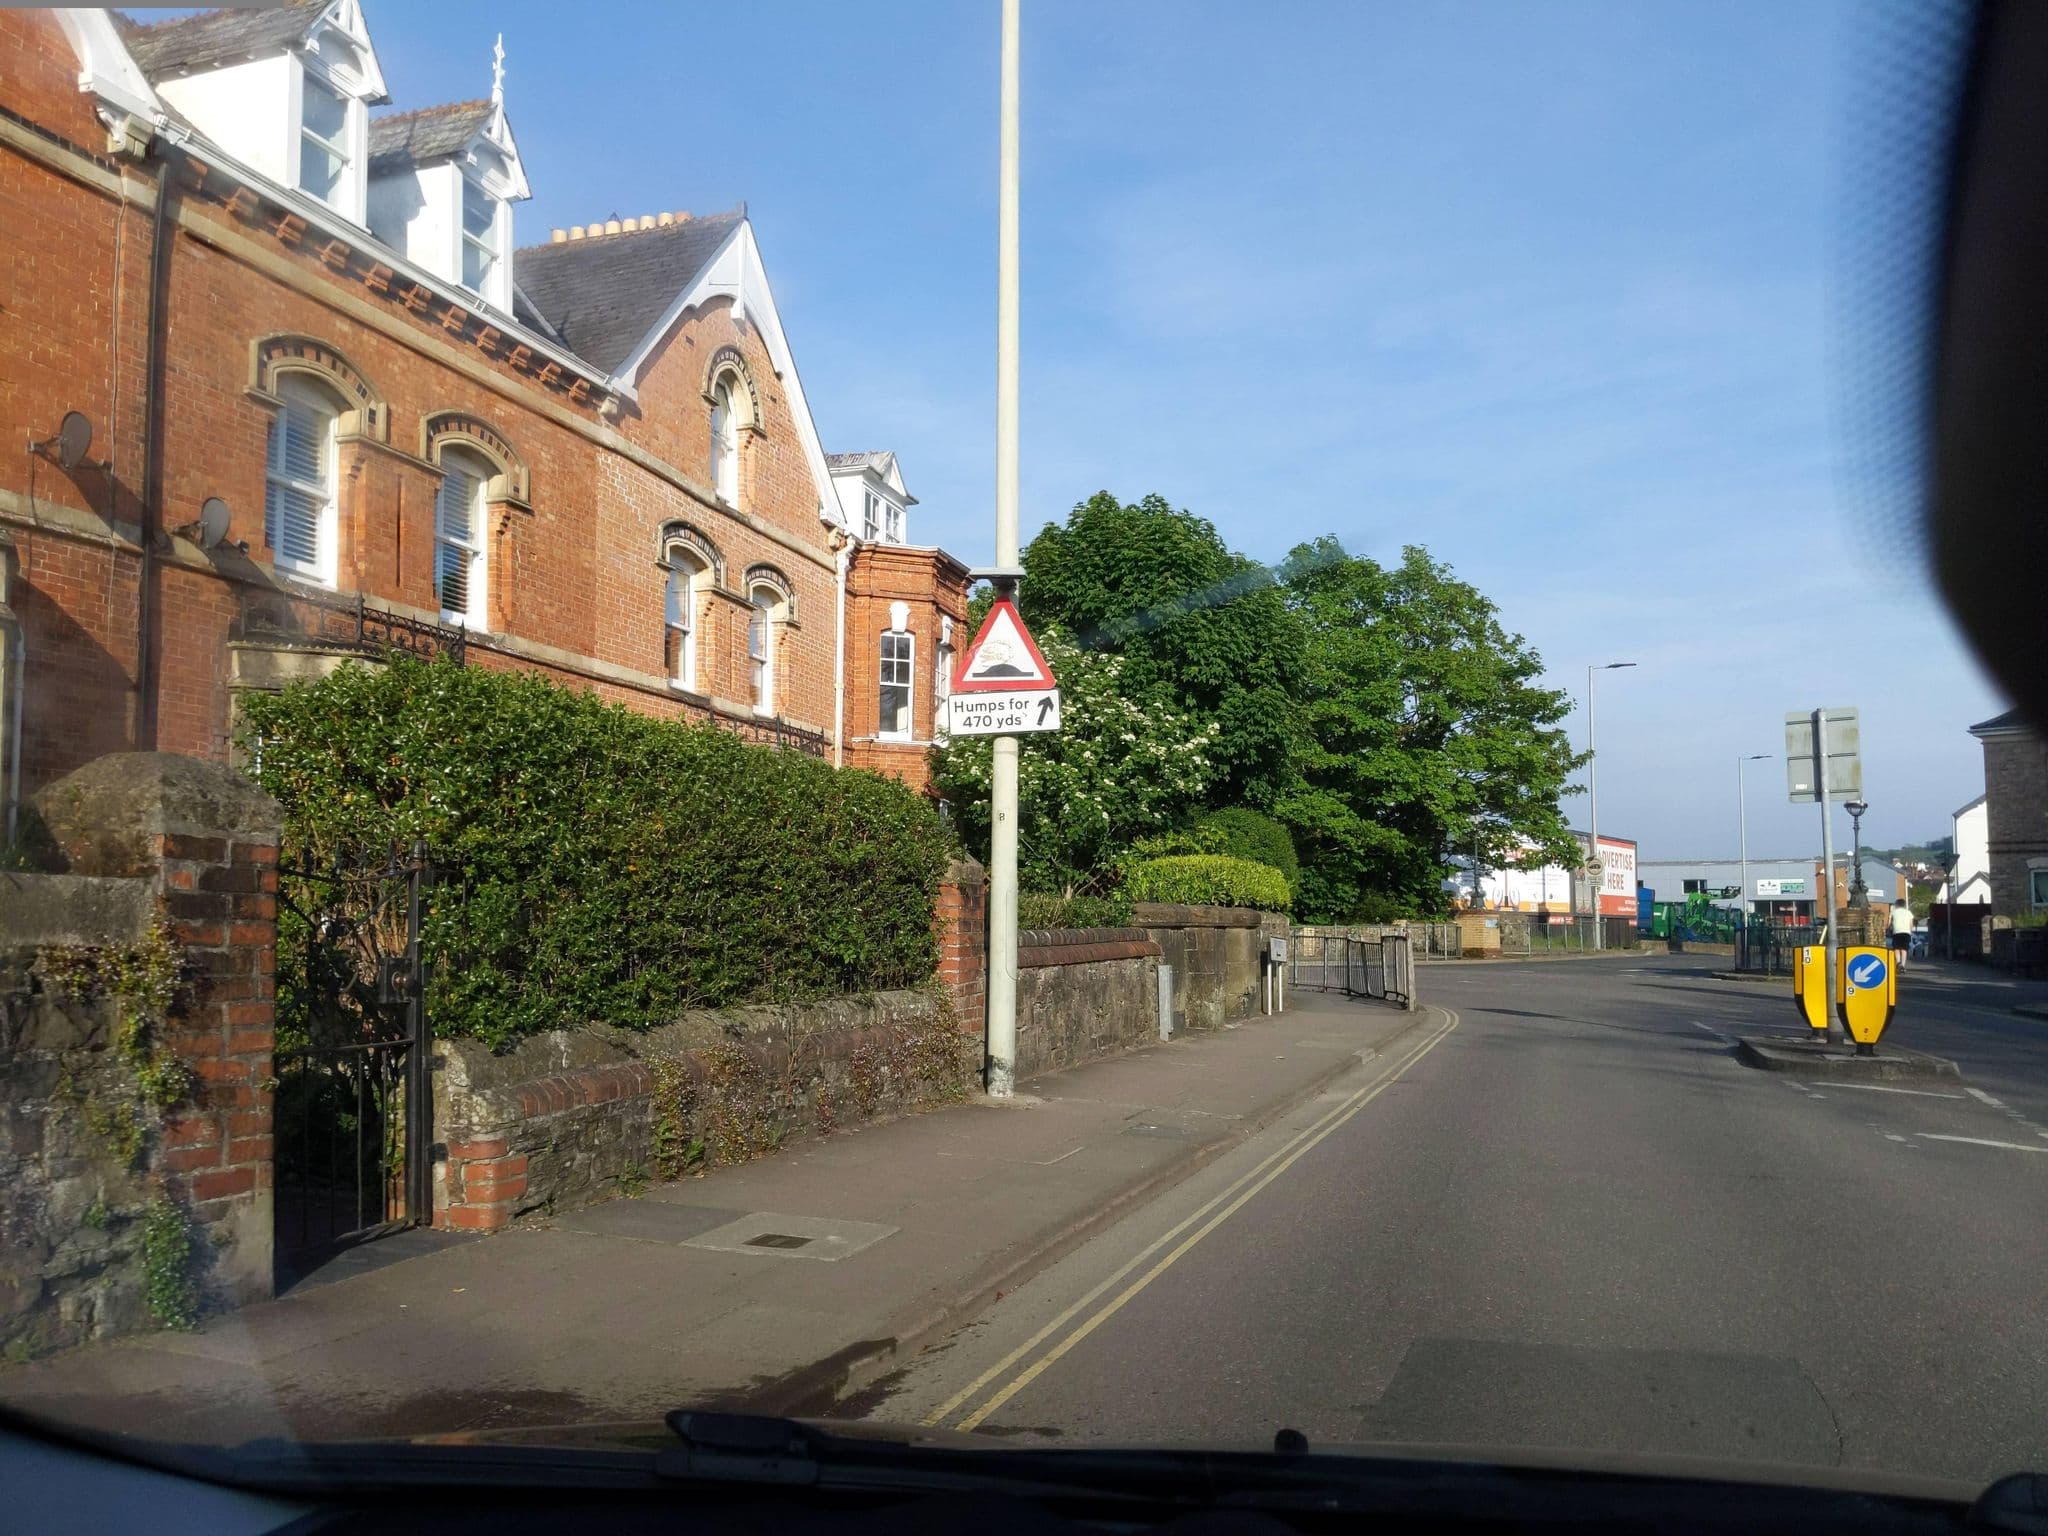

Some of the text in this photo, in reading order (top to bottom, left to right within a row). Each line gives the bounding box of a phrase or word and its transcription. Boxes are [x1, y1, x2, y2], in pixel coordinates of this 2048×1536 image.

[954, 698, 1030, 713] Humps for
[962, 714, 1022, 729] 470 yds
[1607, 872, 1624, 890] HERE
[1848, 987, 1855, 995] 9
